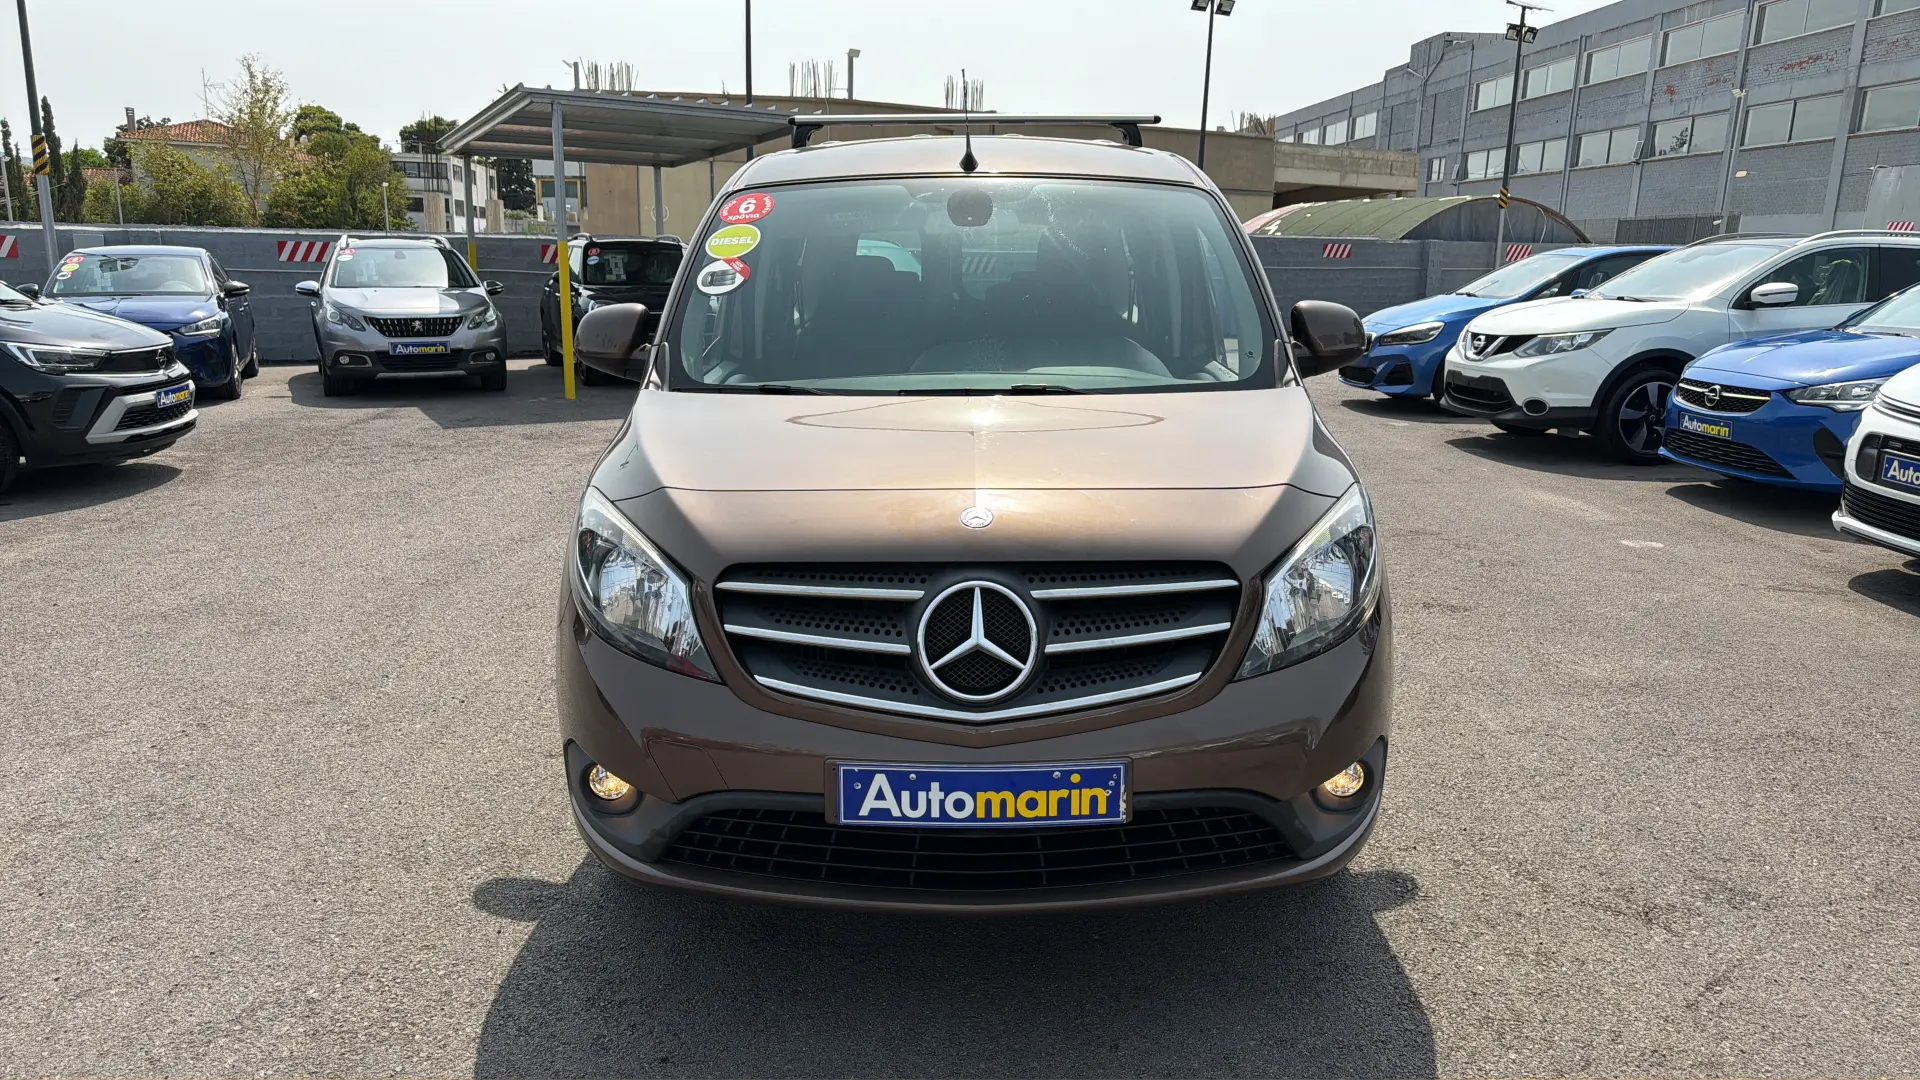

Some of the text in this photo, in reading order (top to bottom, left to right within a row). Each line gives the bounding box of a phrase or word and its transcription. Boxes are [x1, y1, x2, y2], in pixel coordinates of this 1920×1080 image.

[739, 199, 757, 215] 6
[727, 213, 760, 221] χρόνια
[711, 236, 754, 246] DIESEL
[395, 343, 446, 353] Automarin
[160, 387, 189, 405] Automarin
[1683, 414, 1730, 437] Automarin
[858, 773, 1107, 819] Automarin
